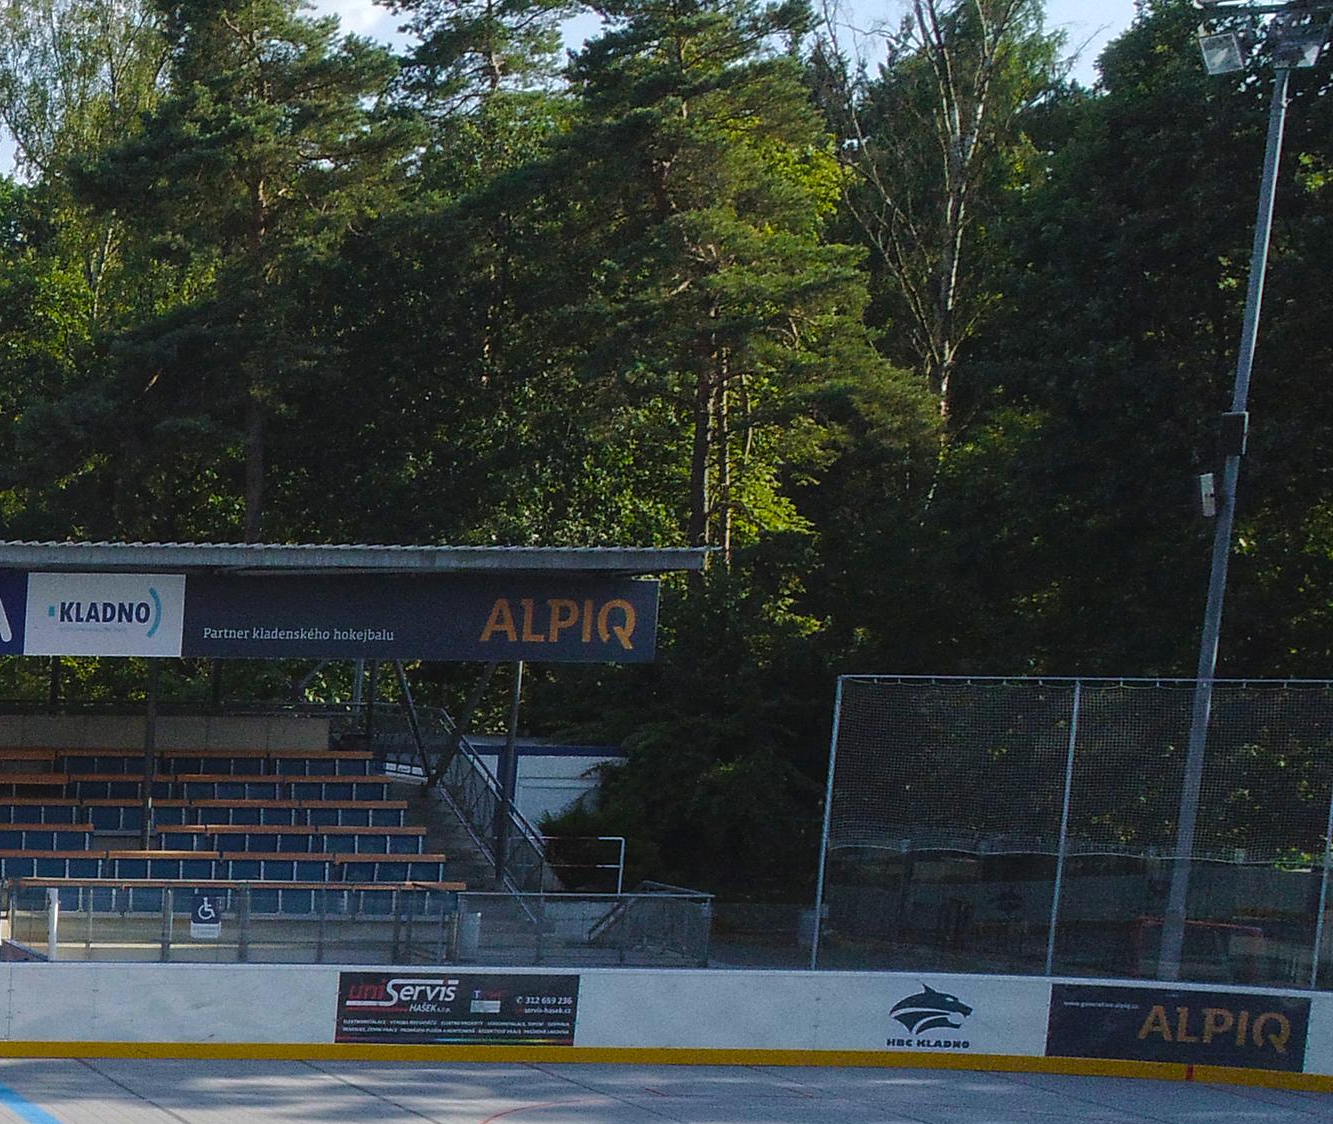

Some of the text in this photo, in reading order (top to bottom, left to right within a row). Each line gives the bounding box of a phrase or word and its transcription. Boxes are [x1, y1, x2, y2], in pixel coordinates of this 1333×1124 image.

[60, 602, 150, 623] KLADNO
[480, 598, 636, 649] ALPIQ
[203, 627, 394, 643] Partner kladenského hokejbalu
[409, 1002, 437, 1013] HAŠEK
[1138, 1005, 1291, 1053] ALPIQ
[886, 1039, 970, 1048] HBC KLADNO
